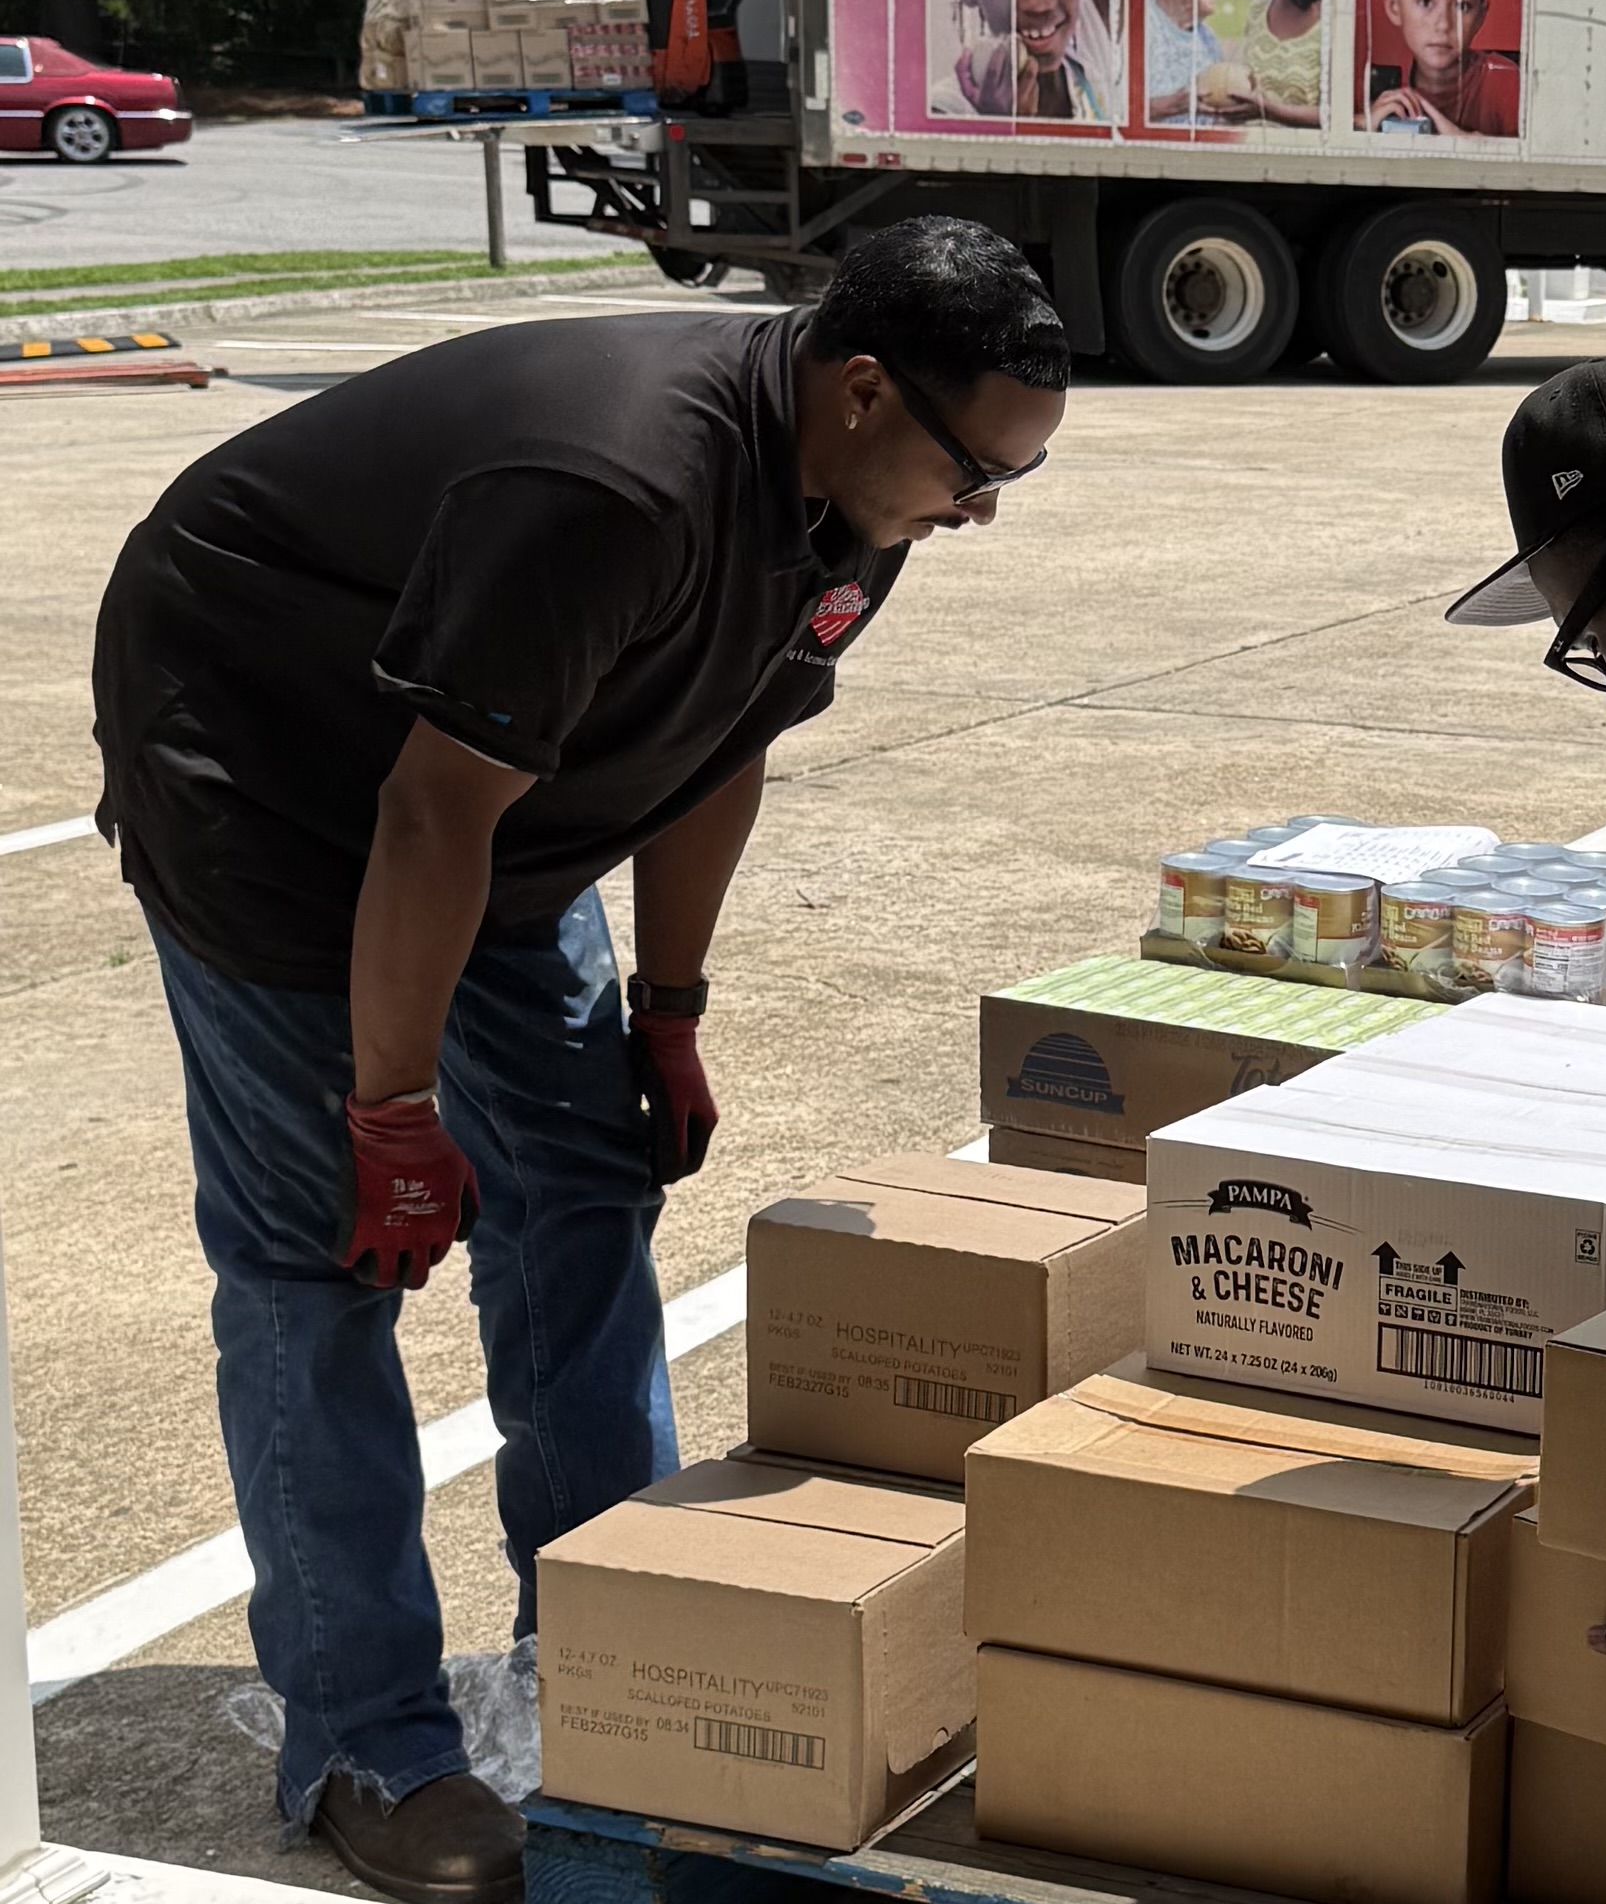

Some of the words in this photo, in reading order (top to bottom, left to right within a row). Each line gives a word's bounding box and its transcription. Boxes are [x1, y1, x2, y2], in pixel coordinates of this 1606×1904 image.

[1231, 1051, 1301, 1096] Tot
[1227, 1185, 1293, 1211] PAMPA
[1171, 1234, 1344, 1291] MACARONI
[1432, 1267, 1442, 1276] UP
[1191, 1275, 1207, 1301] &
[1213, 1269, 1325, 1320] CHEESE
[1385, 1283, 1453, 1306] FRAGILE
[1460, 1289, 1514, 1306] DISTRIBUTED
[836, 1322, 961, 1359] HOSPITALITY
[1196, 1309, 1257, 1333] NATURALLY
[1259, 1319, 1314, 1342] FLAVORED
[831, 1347, 900, 1370] SCALLOPED
[903, 1359, 968, 1382] POTATOES
[1170, 1341, 1191, 1356] NET
[1194, 1344, 1213, 1360] WT.
[1214, 1349, 1228, 1362] 24
[1231, 1354, 1238, 1364] x
[1263, 1356, 1279, 1371] OZ
[1280, 1359, 1298, 1375] (24
[1300, 1365, 1307, 1375] x
[632, 1661, 765, 1699] HOSPITALITY
[628, 1688, 700, 1711] SCALLOPED
[704, 1700, 771, 1723] POTATOES
